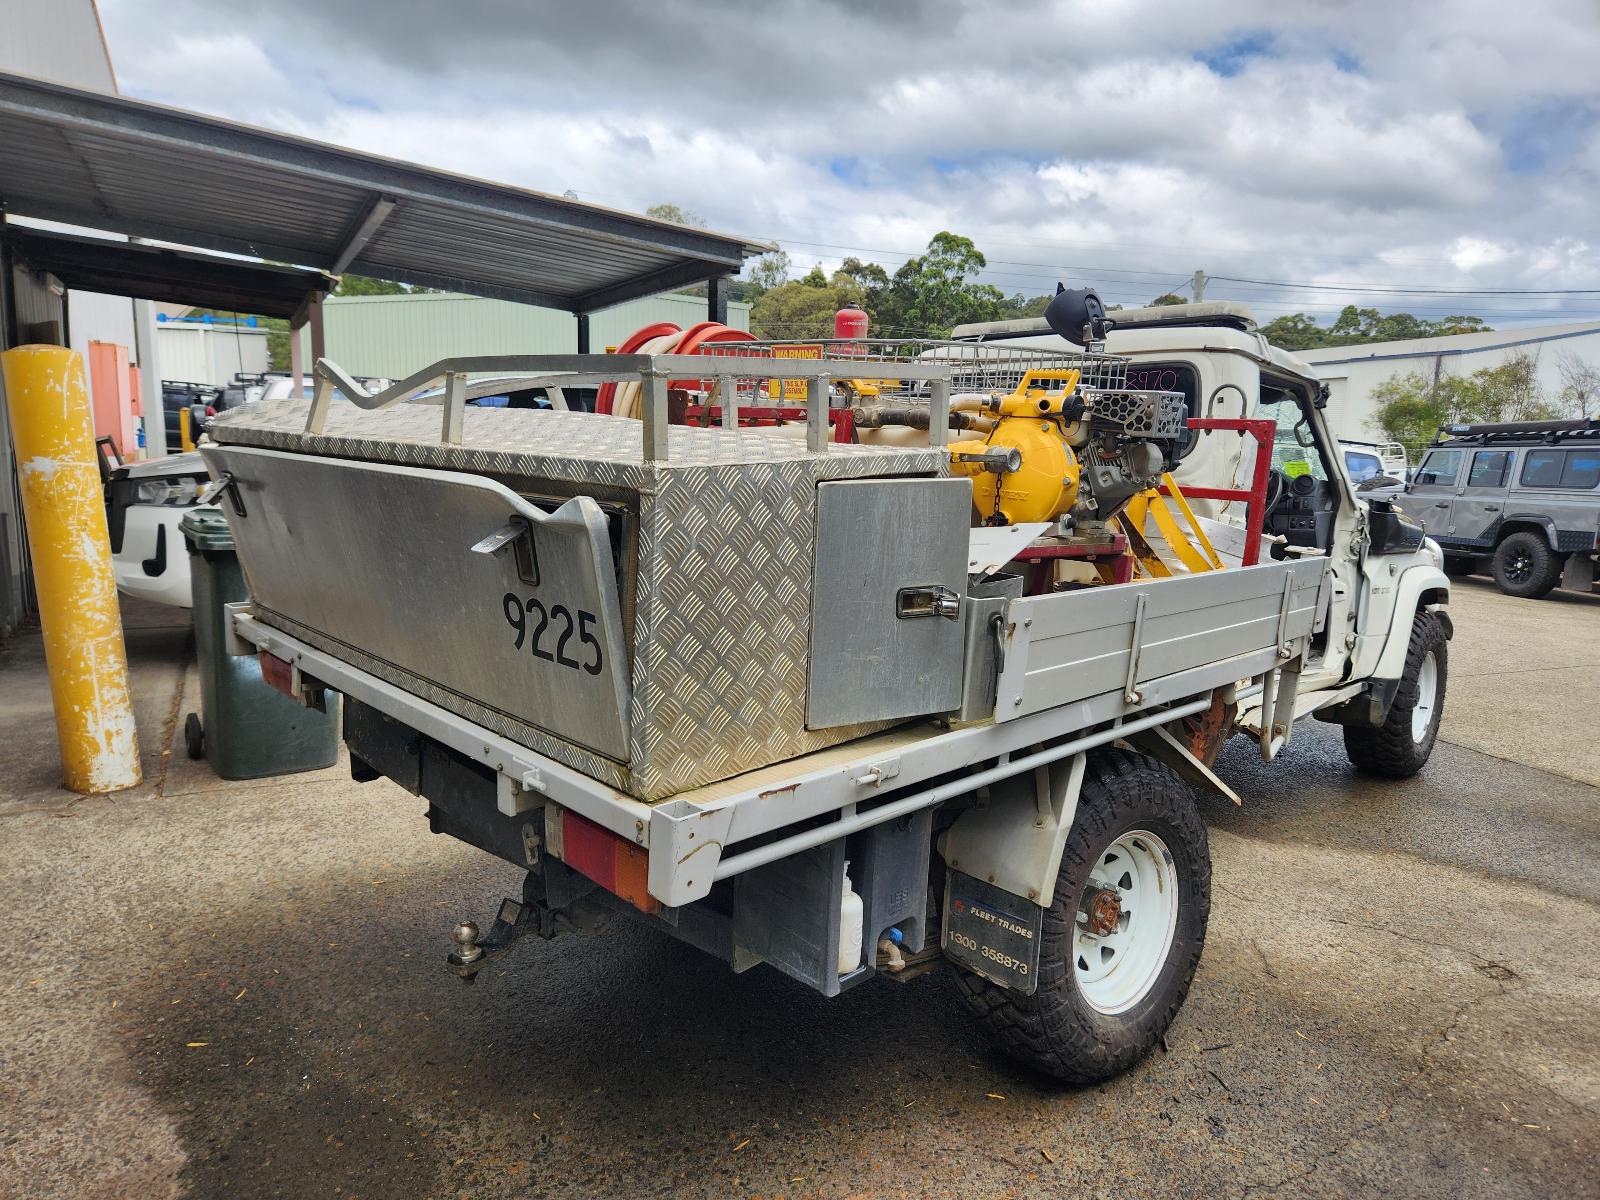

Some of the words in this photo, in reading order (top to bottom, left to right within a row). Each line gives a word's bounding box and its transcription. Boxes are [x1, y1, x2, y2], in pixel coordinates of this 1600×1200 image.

[775, 349, 818, 359] WARNING
[503, 592, 602, 675] 9225
[970, 906, 996, 923] FLEET
[998, 918, 1033, 939] TRADES
[949, 930, 977, 951] 1300
[981, 945, 1028, 975] 358873
